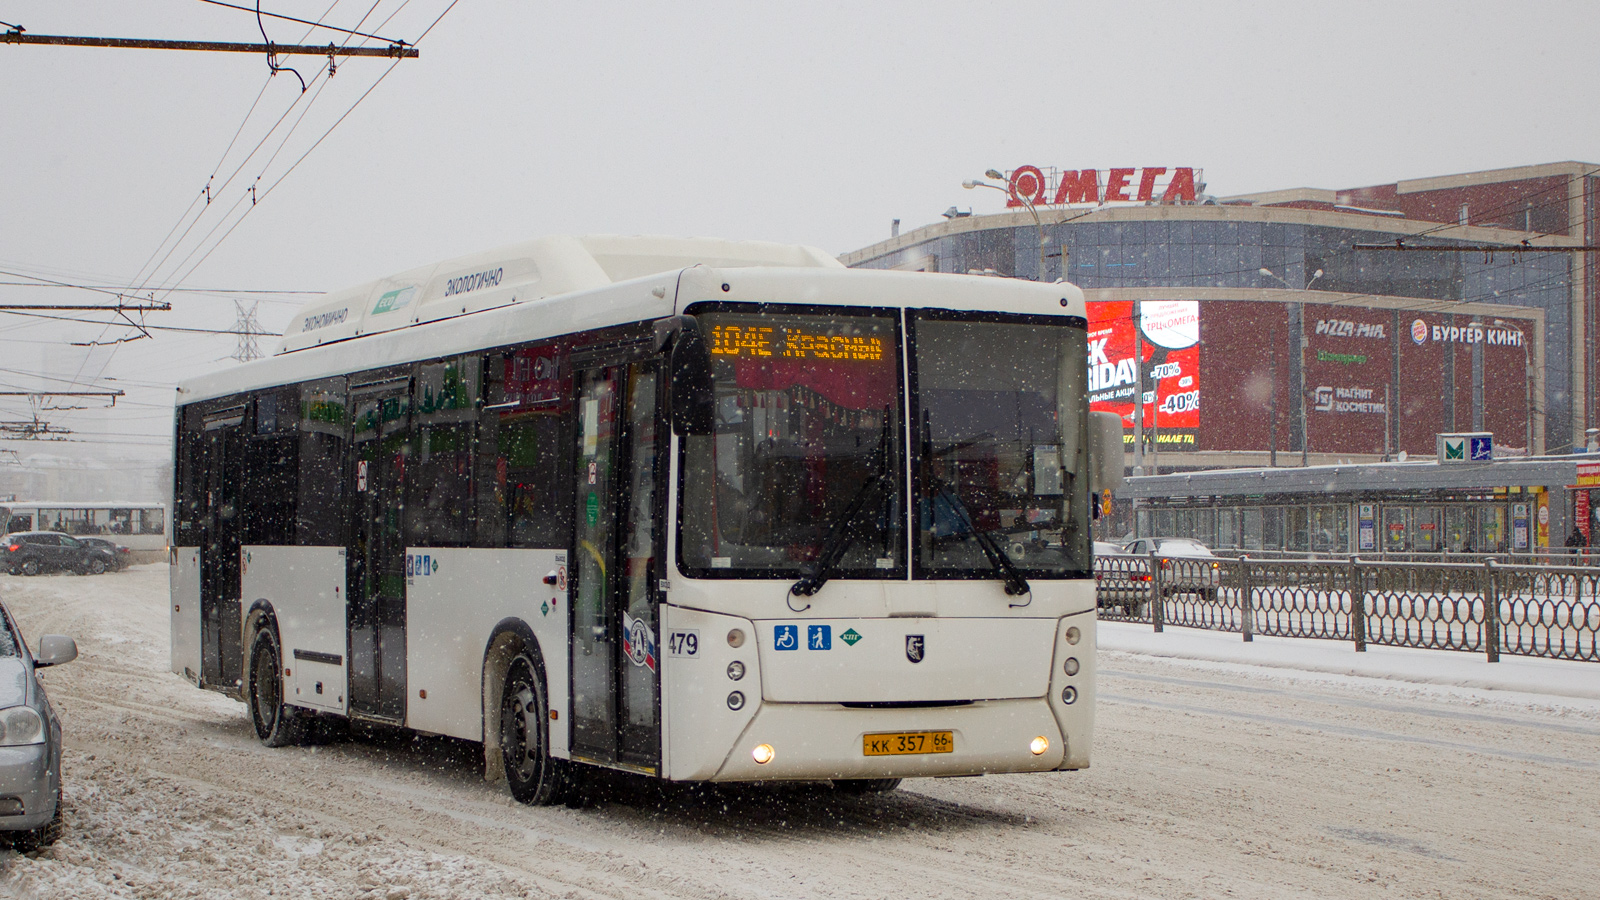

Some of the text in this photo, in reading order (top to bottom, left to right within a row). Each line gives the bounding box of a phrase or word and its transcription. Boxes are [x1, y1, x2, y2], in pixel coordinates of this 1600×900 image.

[445, 267, 503, 297] ЭКОЛОГИЧНО
[302, 308, 348, 333] ЭКОНОМИЧНО
[1432, 325, 1523, 347] БУРГЕР КИНГ
[1151, 363, 1180, 378] -70%
[1115, 387, 1135, 398] АКЦИ
[1336, 387, 1373, 399] МАГНИТ
[1160, 392, 1199, 412] -40%
[1336, 401, 1386, 413] КОСМЕТИК
[668, 632, 698, 655] 479
[842, 633, 860, 641] КПГ
[871, 734, 948, 752] КК 357 66
